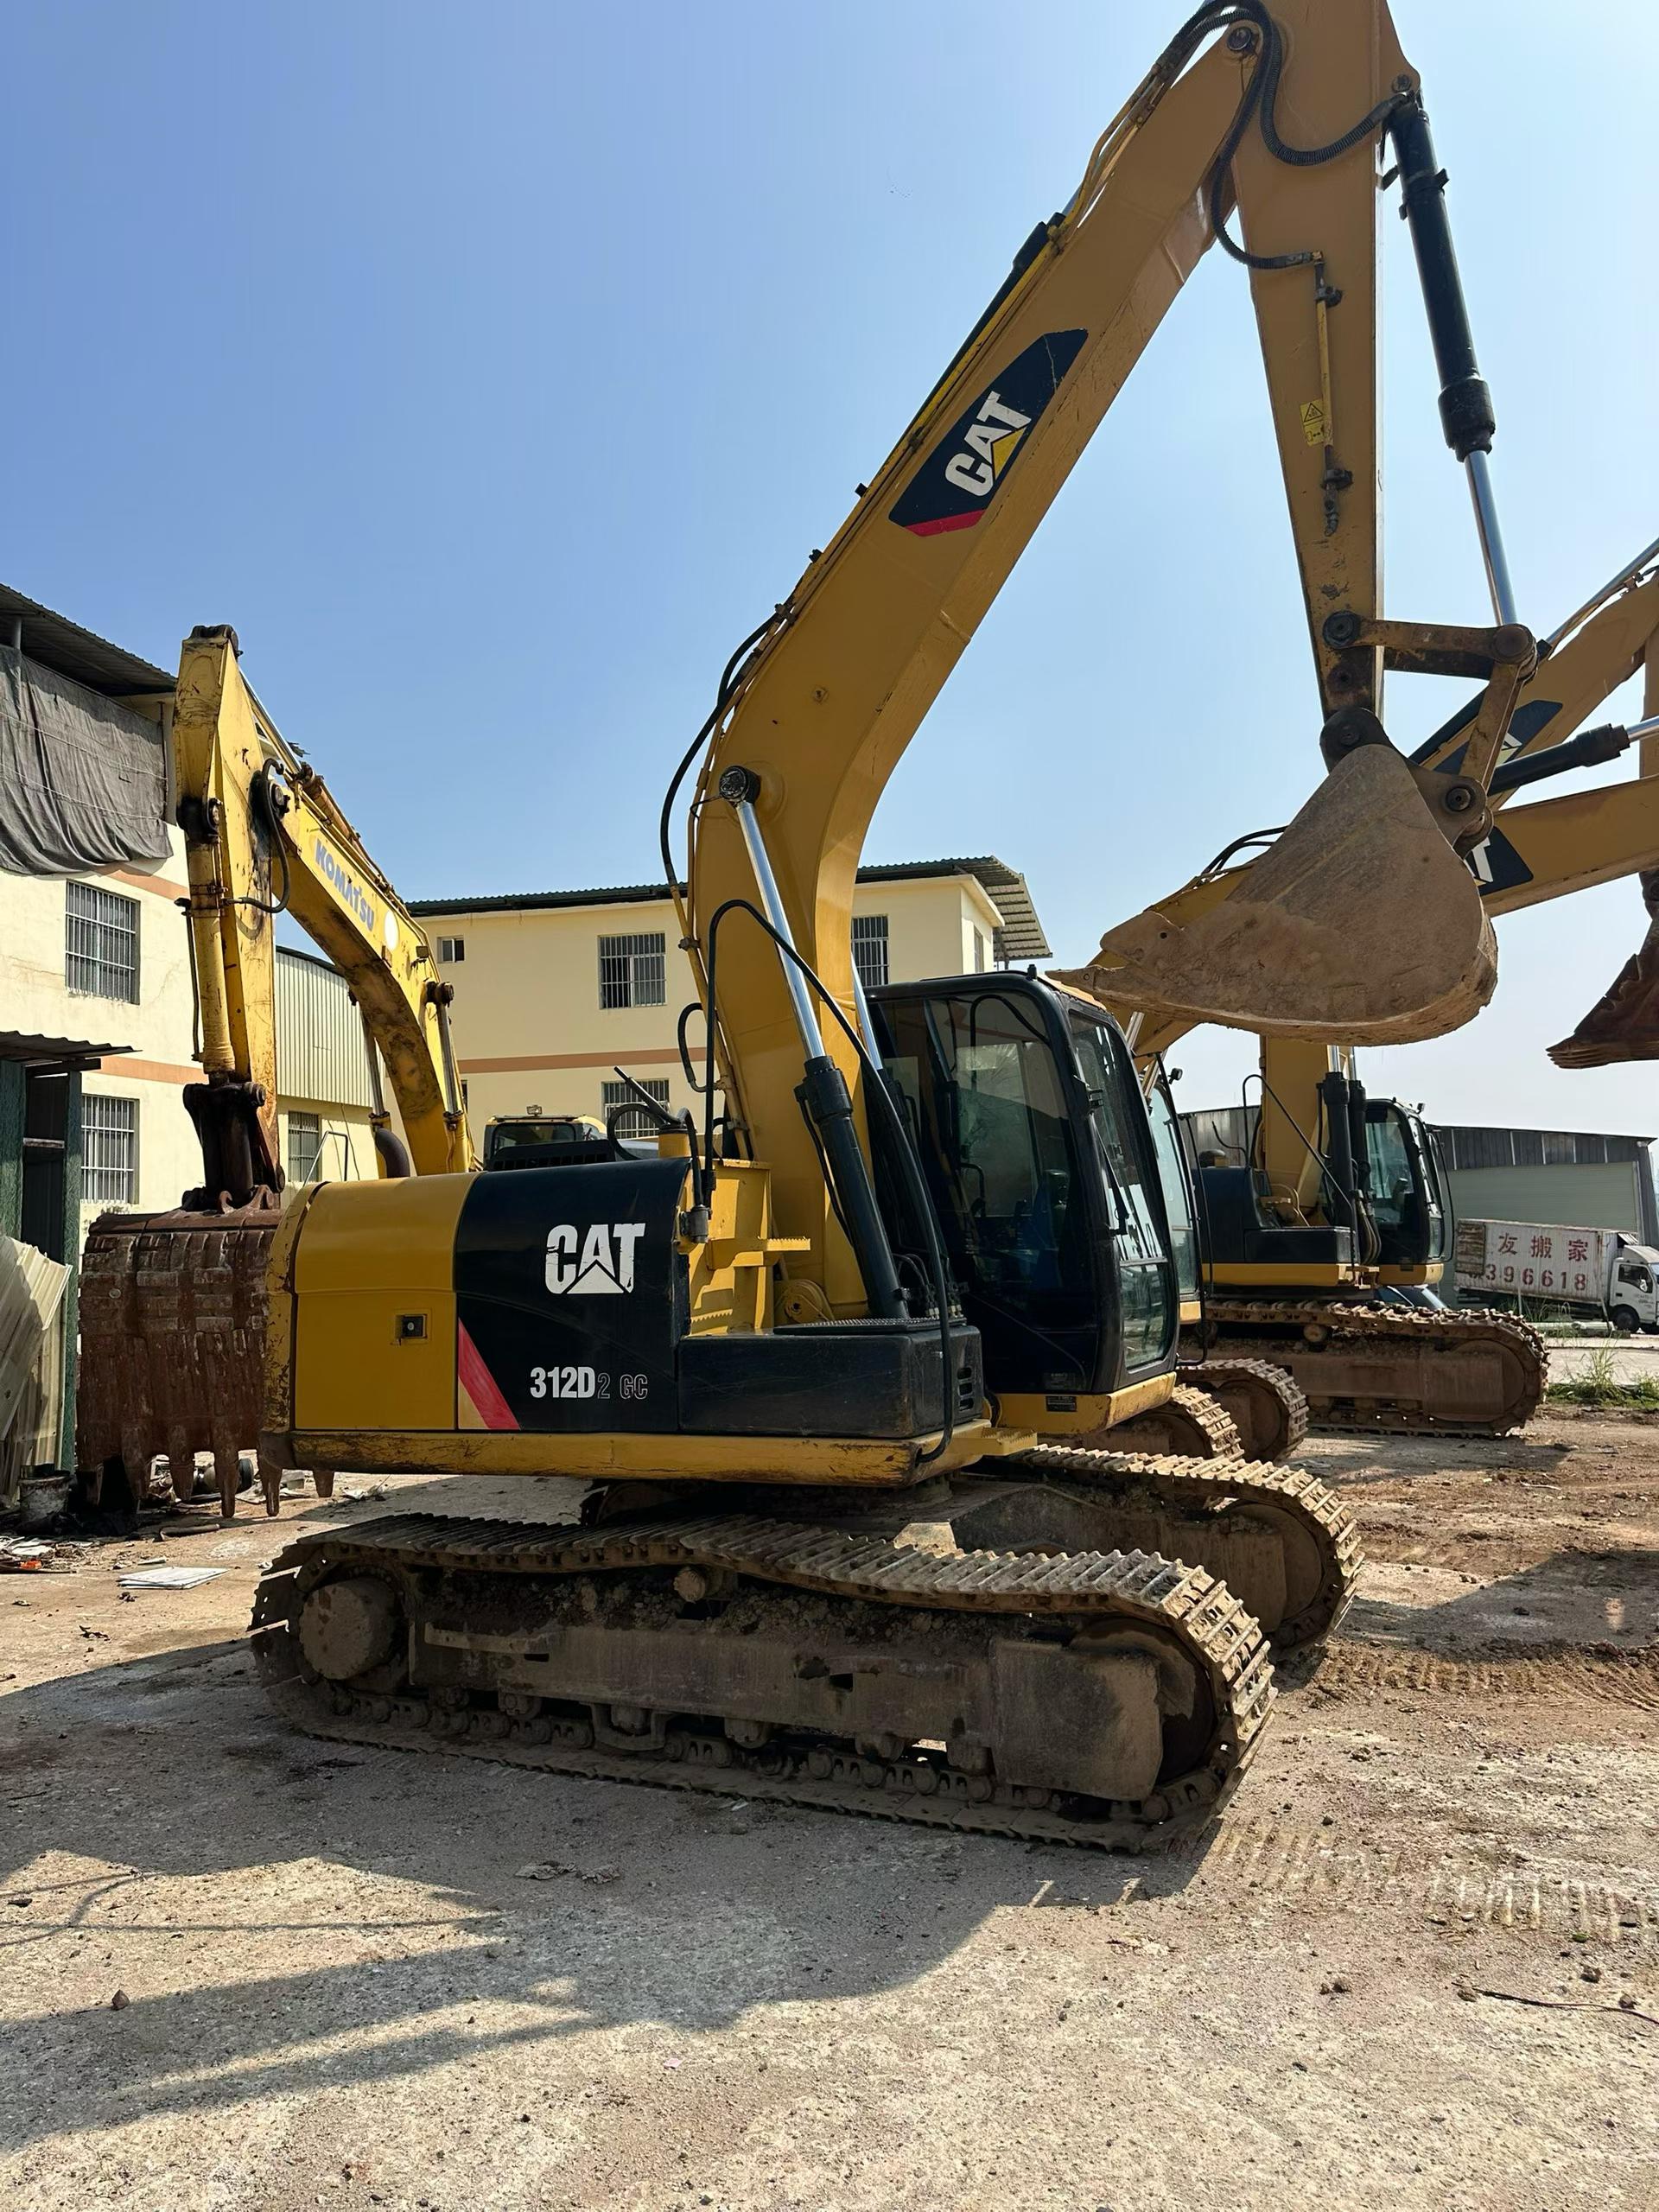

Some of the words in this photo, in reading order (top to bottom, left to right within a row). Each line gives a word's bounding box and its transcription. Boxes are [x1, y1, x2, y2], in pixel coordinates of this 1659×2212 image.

[945, 391, 1032, 497] CAT
[315, 837, 375, 931] KOMATSU
[544, 1223, 646, 1294] CAT
[1498, 1232, 1588, 1262] 友搬家
[1469, 1263, 1586, 1292] 396618
[620, 1374, 648, 1400] GC
